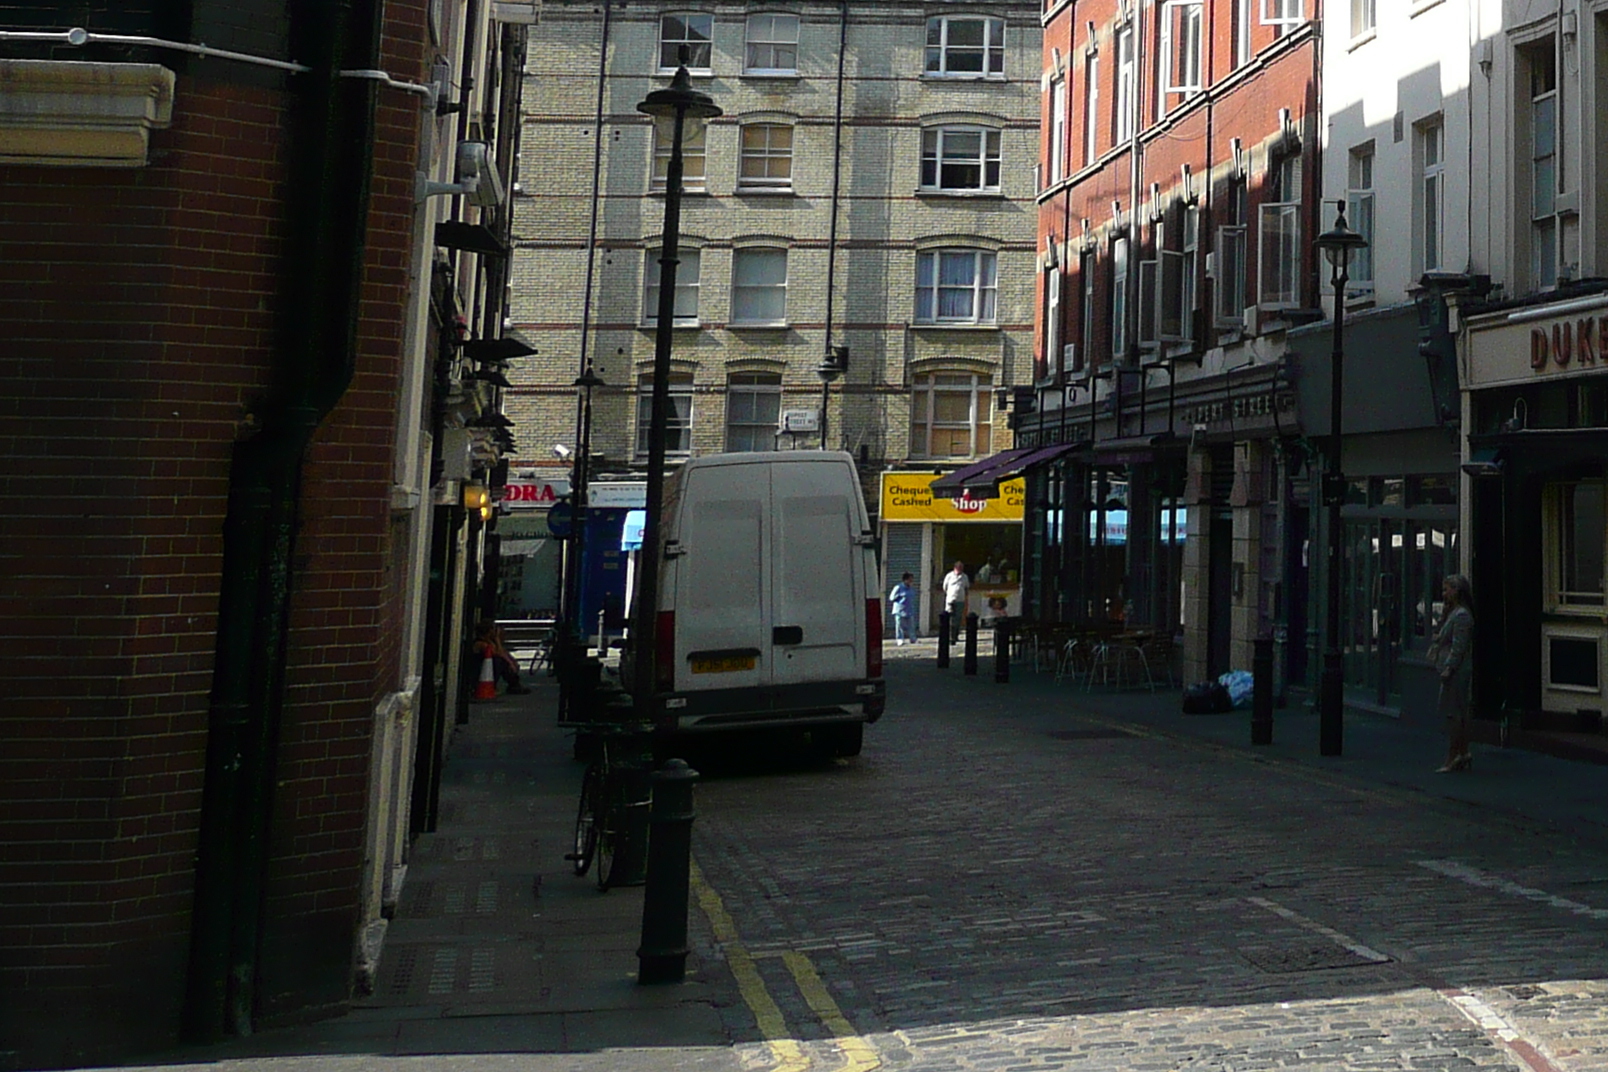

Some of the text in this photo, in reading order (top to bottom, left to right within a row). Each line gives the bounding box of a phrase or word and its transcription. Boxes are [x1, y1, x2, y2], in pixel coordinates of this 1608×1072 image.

[503, 483, 557, 501] DRA
[889, 485, 932, 496] Cheque
[892, 497, 932, 507] Cashed
[951, 496, 988, 513] Shop
